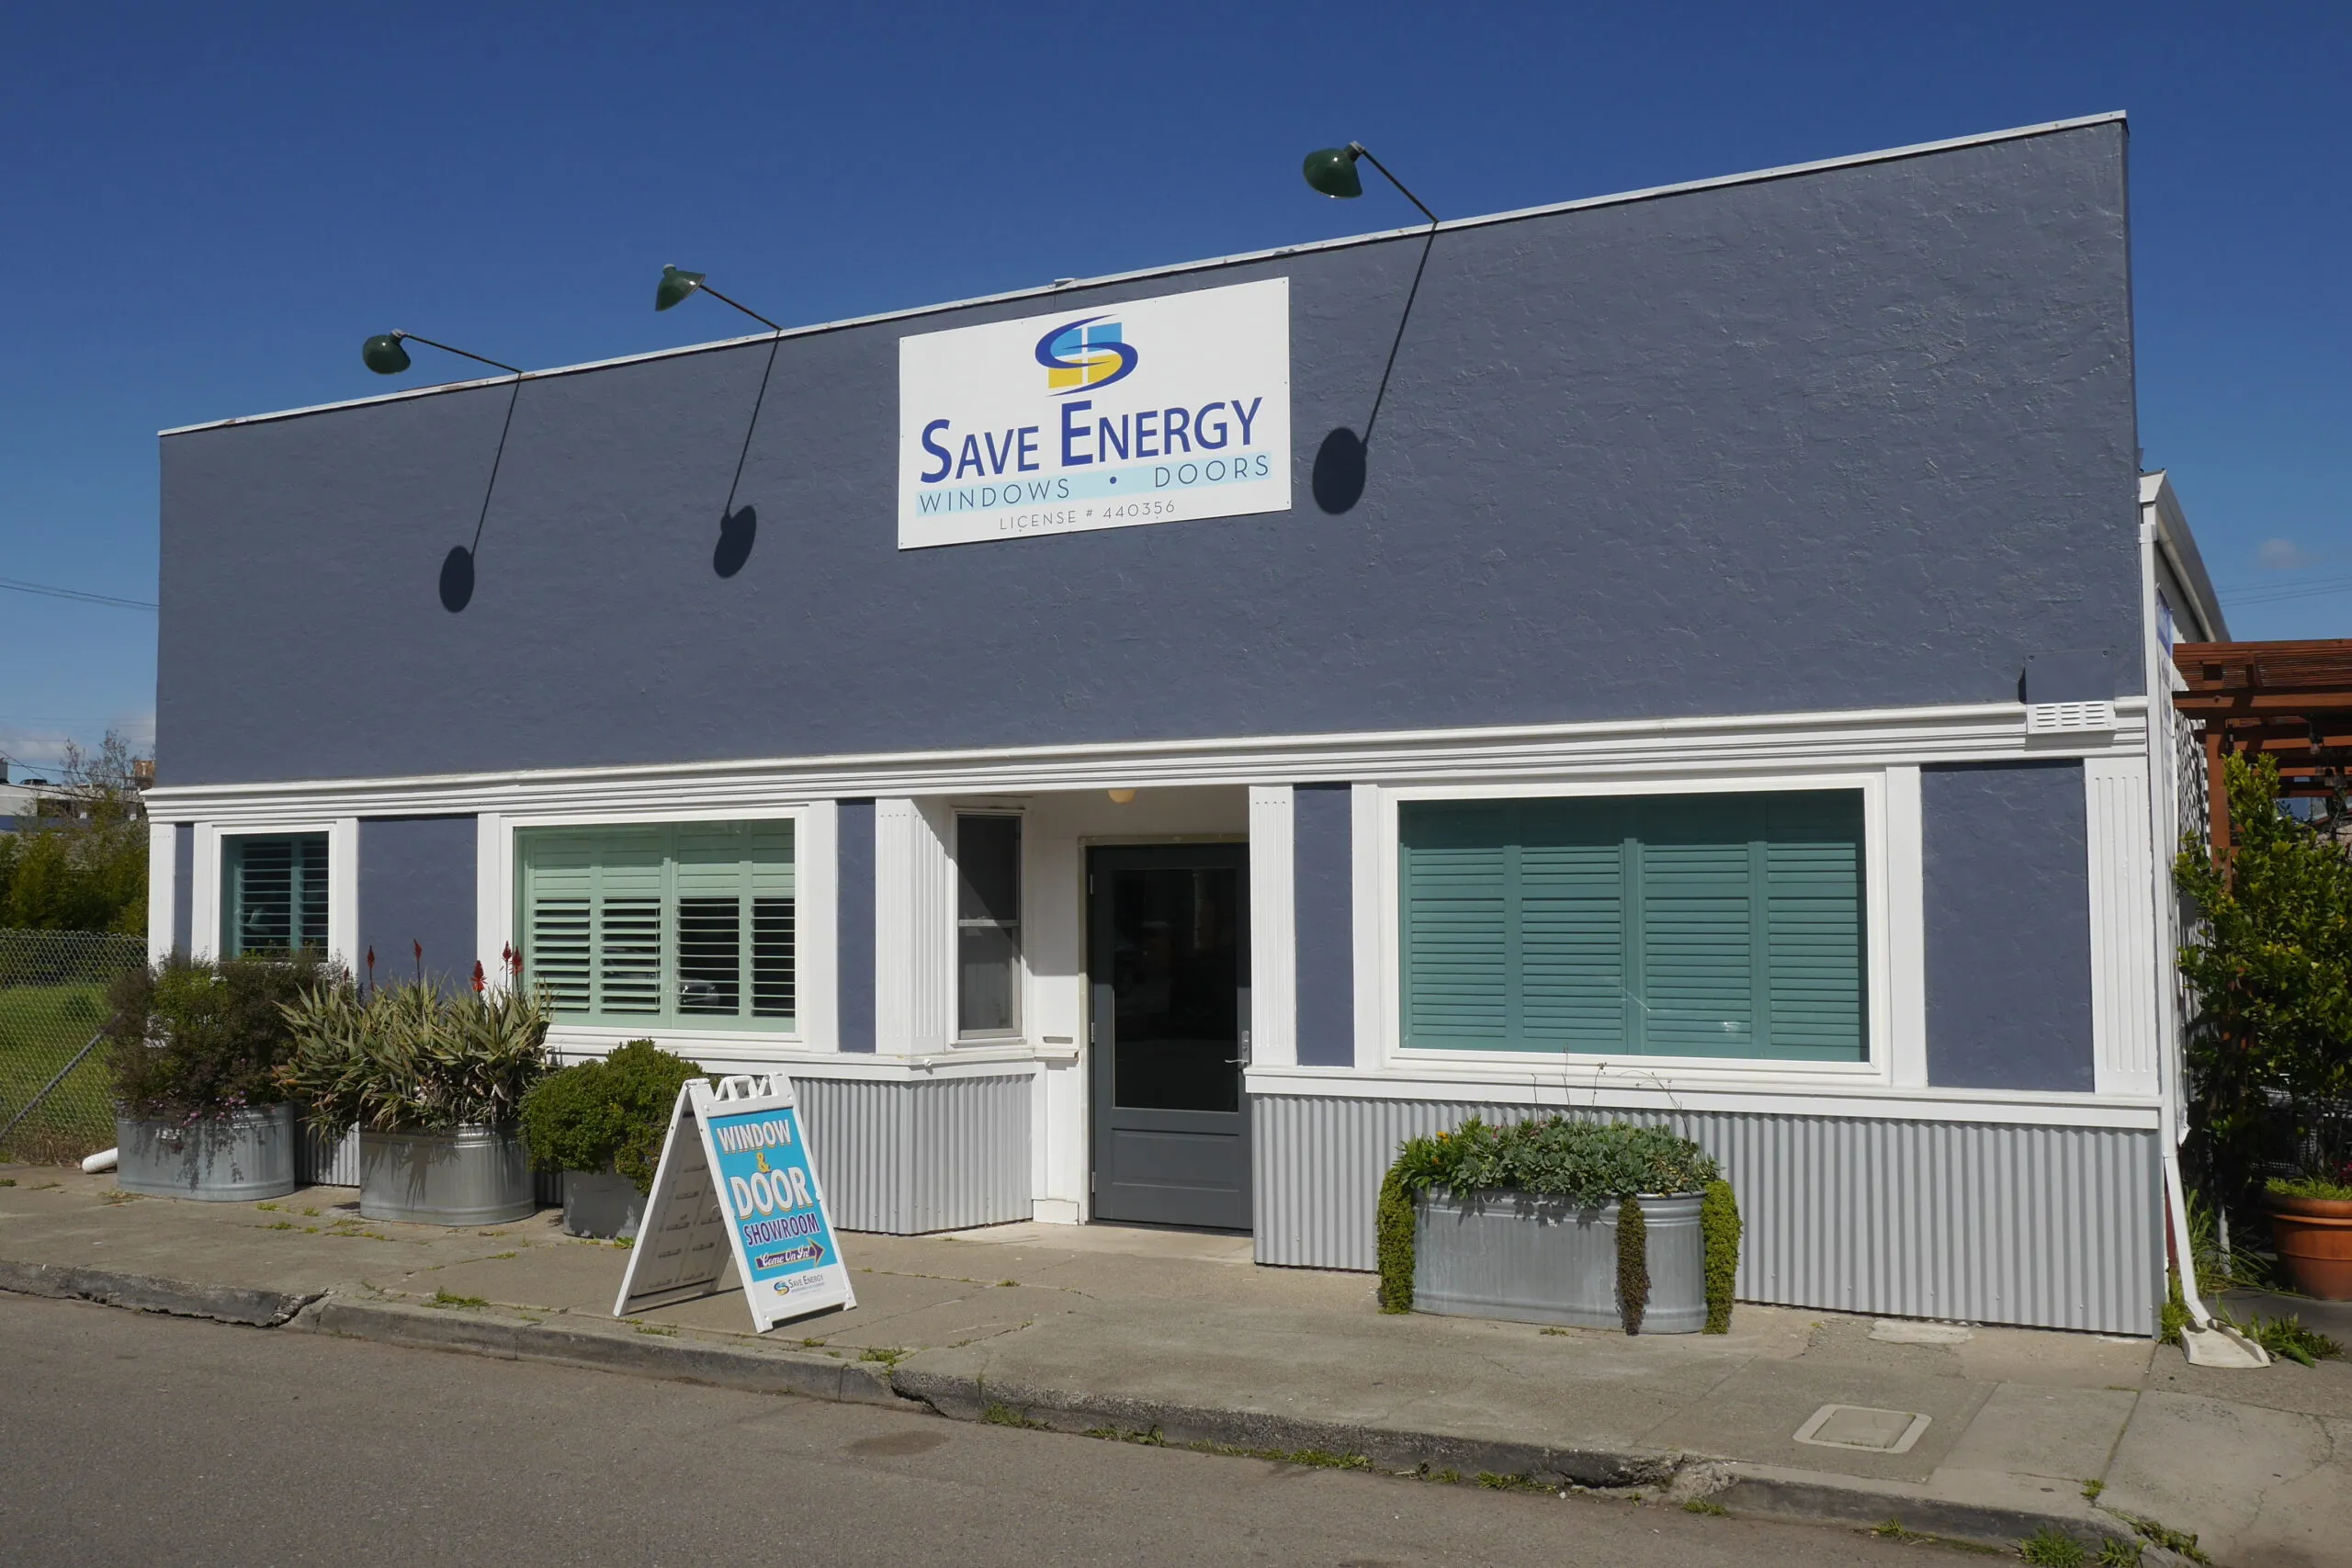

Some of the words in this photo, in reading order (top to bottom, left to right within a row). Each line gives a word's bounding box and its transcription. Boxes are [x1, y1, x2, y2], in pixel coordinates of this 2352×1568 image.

[920, 419, 1040, 483] SAVE
[1061, 397, 1263, 467] ENERGY
[920, 479, 1069, 513] WINDOWS
[1154, 455, 1269, 488] DOORS
[1000, 510, 1077, 530] LICENSE
[1086, 508, 1093, 517] #
[1102, 500, 1175, 520] 440356
[717, 1119, 791, 1154] WINDOW
[756, 1152, 770, 1173] &
[729, 1167, 813, 1220] DOOR
[744, 1213, 820, 1246] SHOWROOM
[761, 1252, 785, 1267] Come
[786, 1250, 796, 1261] On
[788, 1279, 803, 1288] SAVE
[803, 1274, 823, 1285] ENERGY
